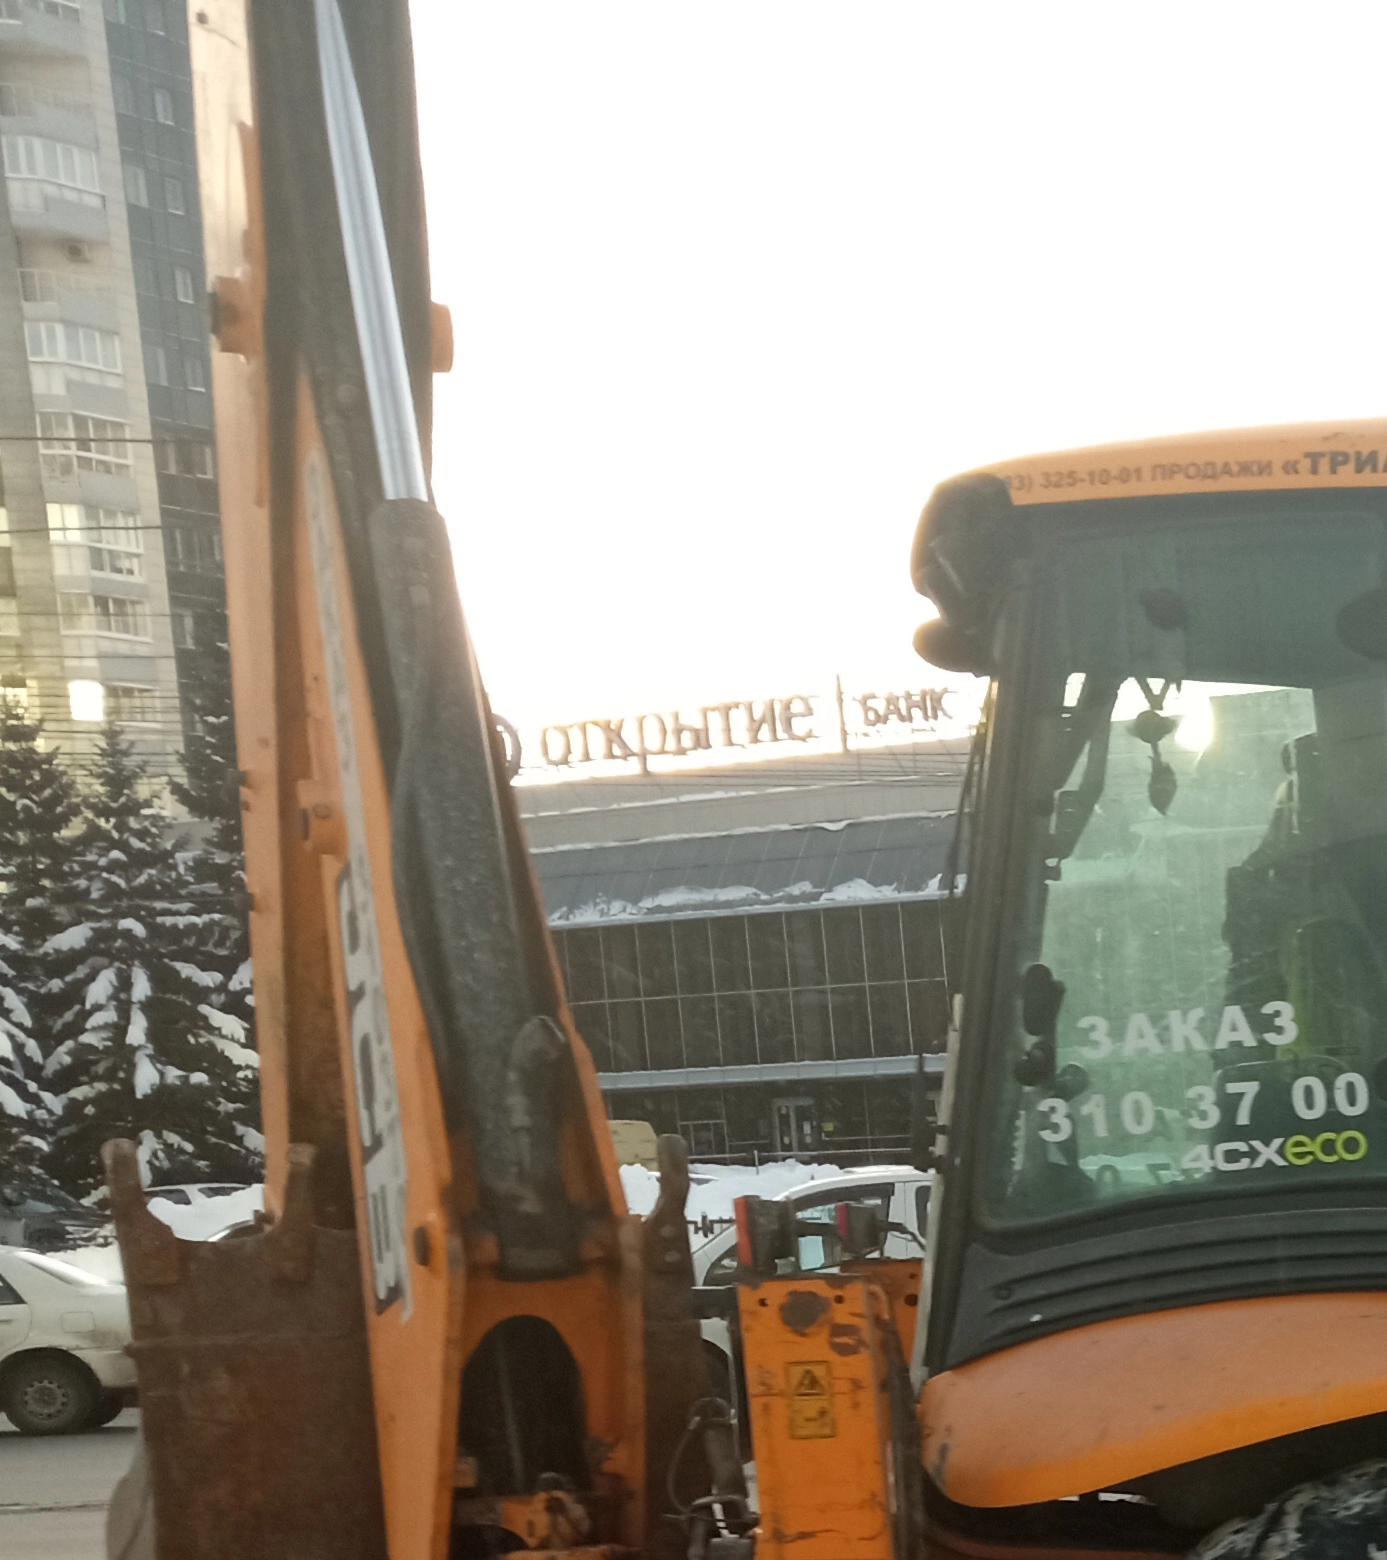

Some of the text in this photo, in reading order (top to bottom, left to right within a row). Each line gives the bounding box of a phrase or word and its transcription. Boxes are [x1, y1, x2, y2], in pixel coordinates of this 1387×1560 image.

[1041, 466, 1143, 490] 325-10-01
[1151, 460, 1273, 482] ПРОДАЖИ
[1077, 1000, 1299, 1060] ЗАКАЗ
[1038, 1072, 1370, 1143] 310 37 00
[1180, 1129, 1368, 1175] 4CXeco
